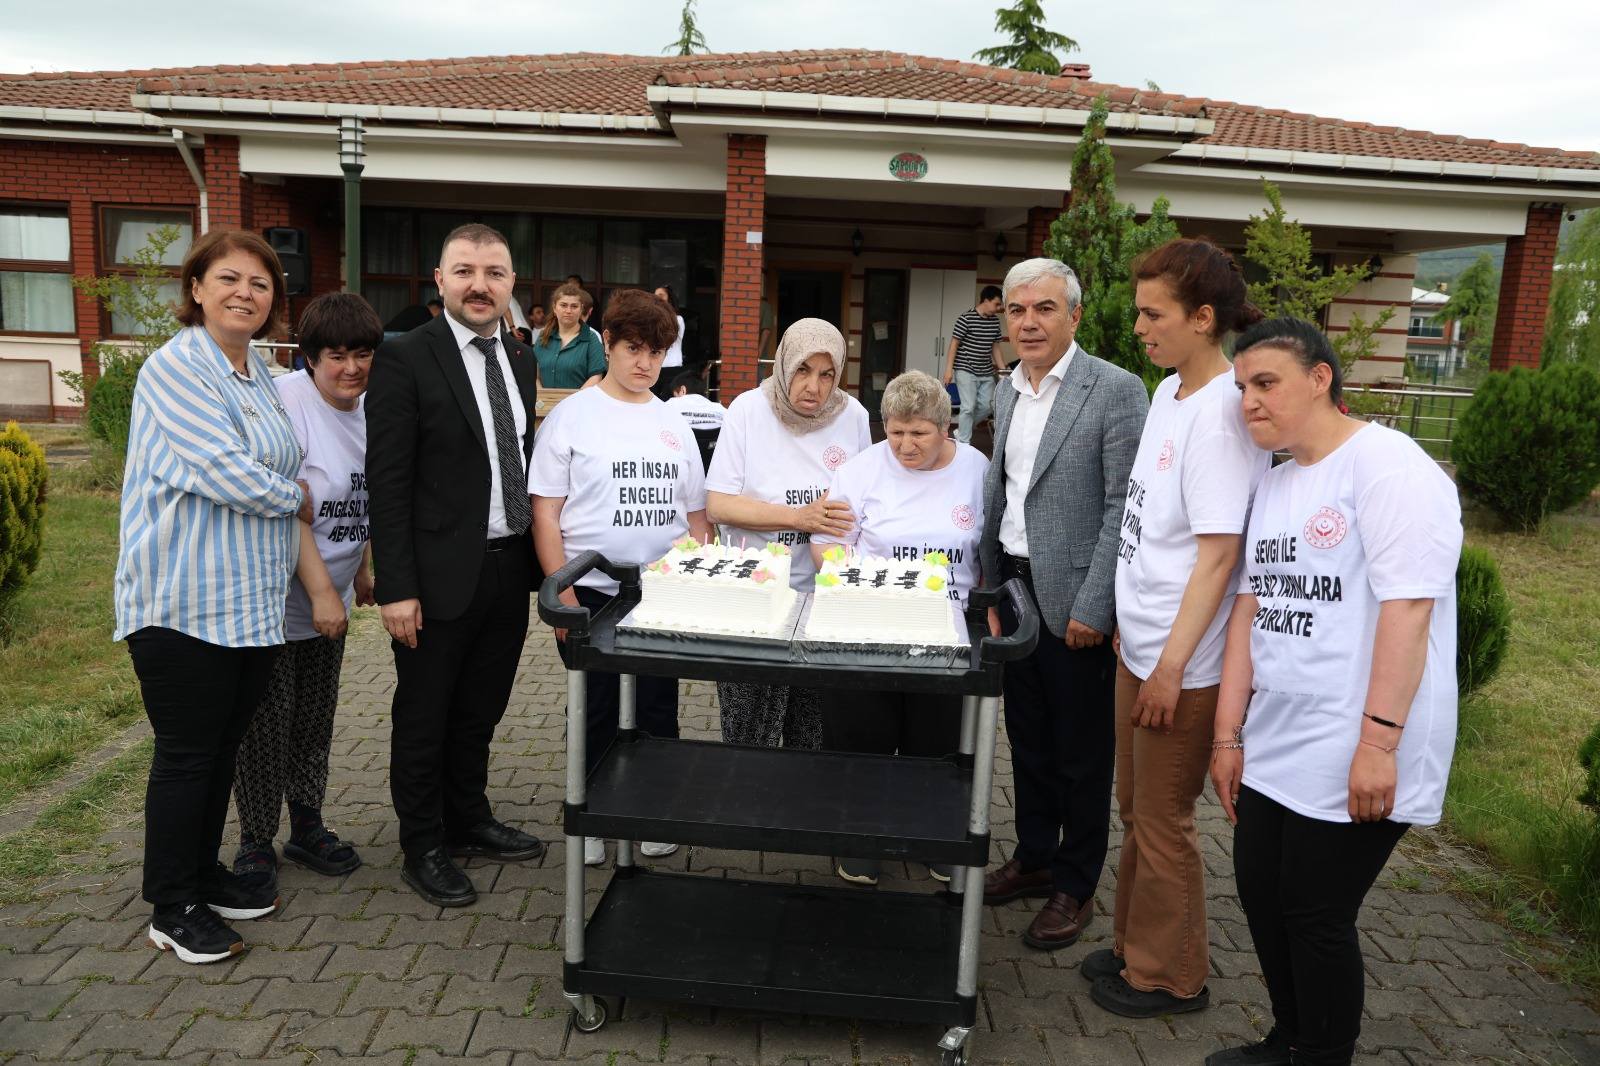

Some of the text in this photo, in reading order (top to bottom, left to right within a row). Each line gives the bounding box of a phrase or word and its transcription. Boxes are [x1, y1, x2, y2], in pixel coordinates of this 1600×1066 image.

[612, 457, 679, 480] HER İNSAN
[619, 483, 673, 504] ENGELLİ
[786, 485, 813, 505] SEVGİ
[328, 525, 350, 542] HEP
[777, 531, 796, 546] HEP
[893, 546, 918, 562] HER
[1254, 531, 1297, 564] SEVGİ İLE
